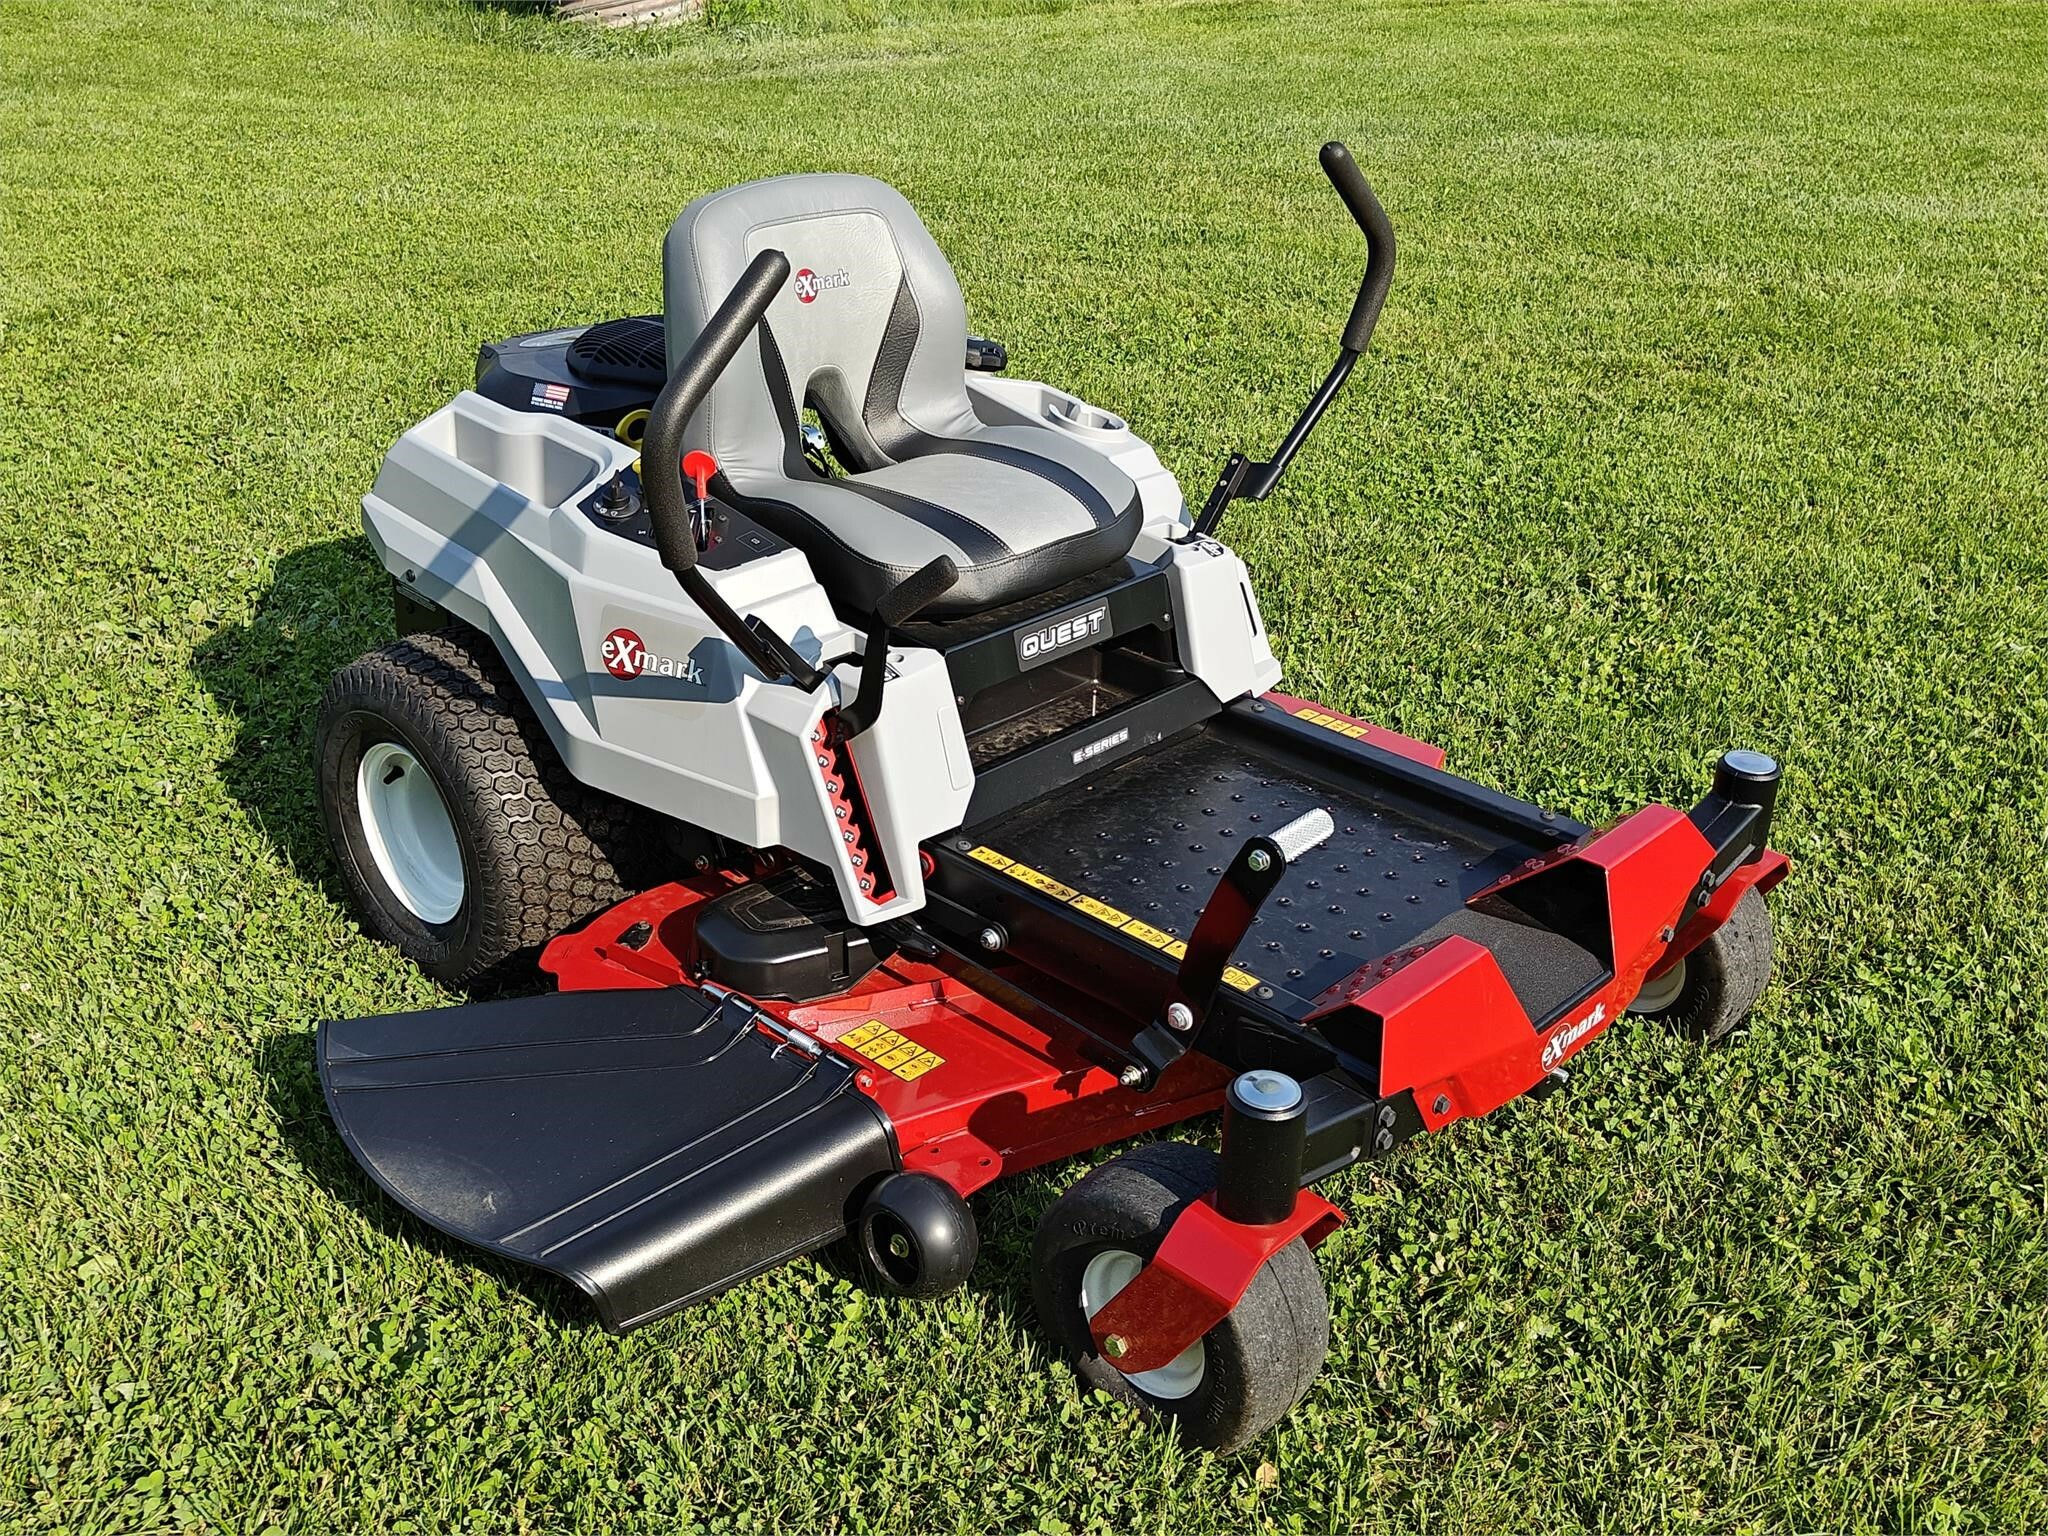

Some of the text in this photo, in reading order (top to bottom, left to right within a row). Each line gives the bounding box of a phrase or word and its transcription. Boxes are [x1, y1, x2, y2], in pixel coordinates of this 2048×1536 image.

[794, 268, 850, 298] eXmark
[1021, 607, 1107, 660] QUEST
[601, 635, 704, 685] eXmark
[1072, 728, 1129, 764] E-SERIES
